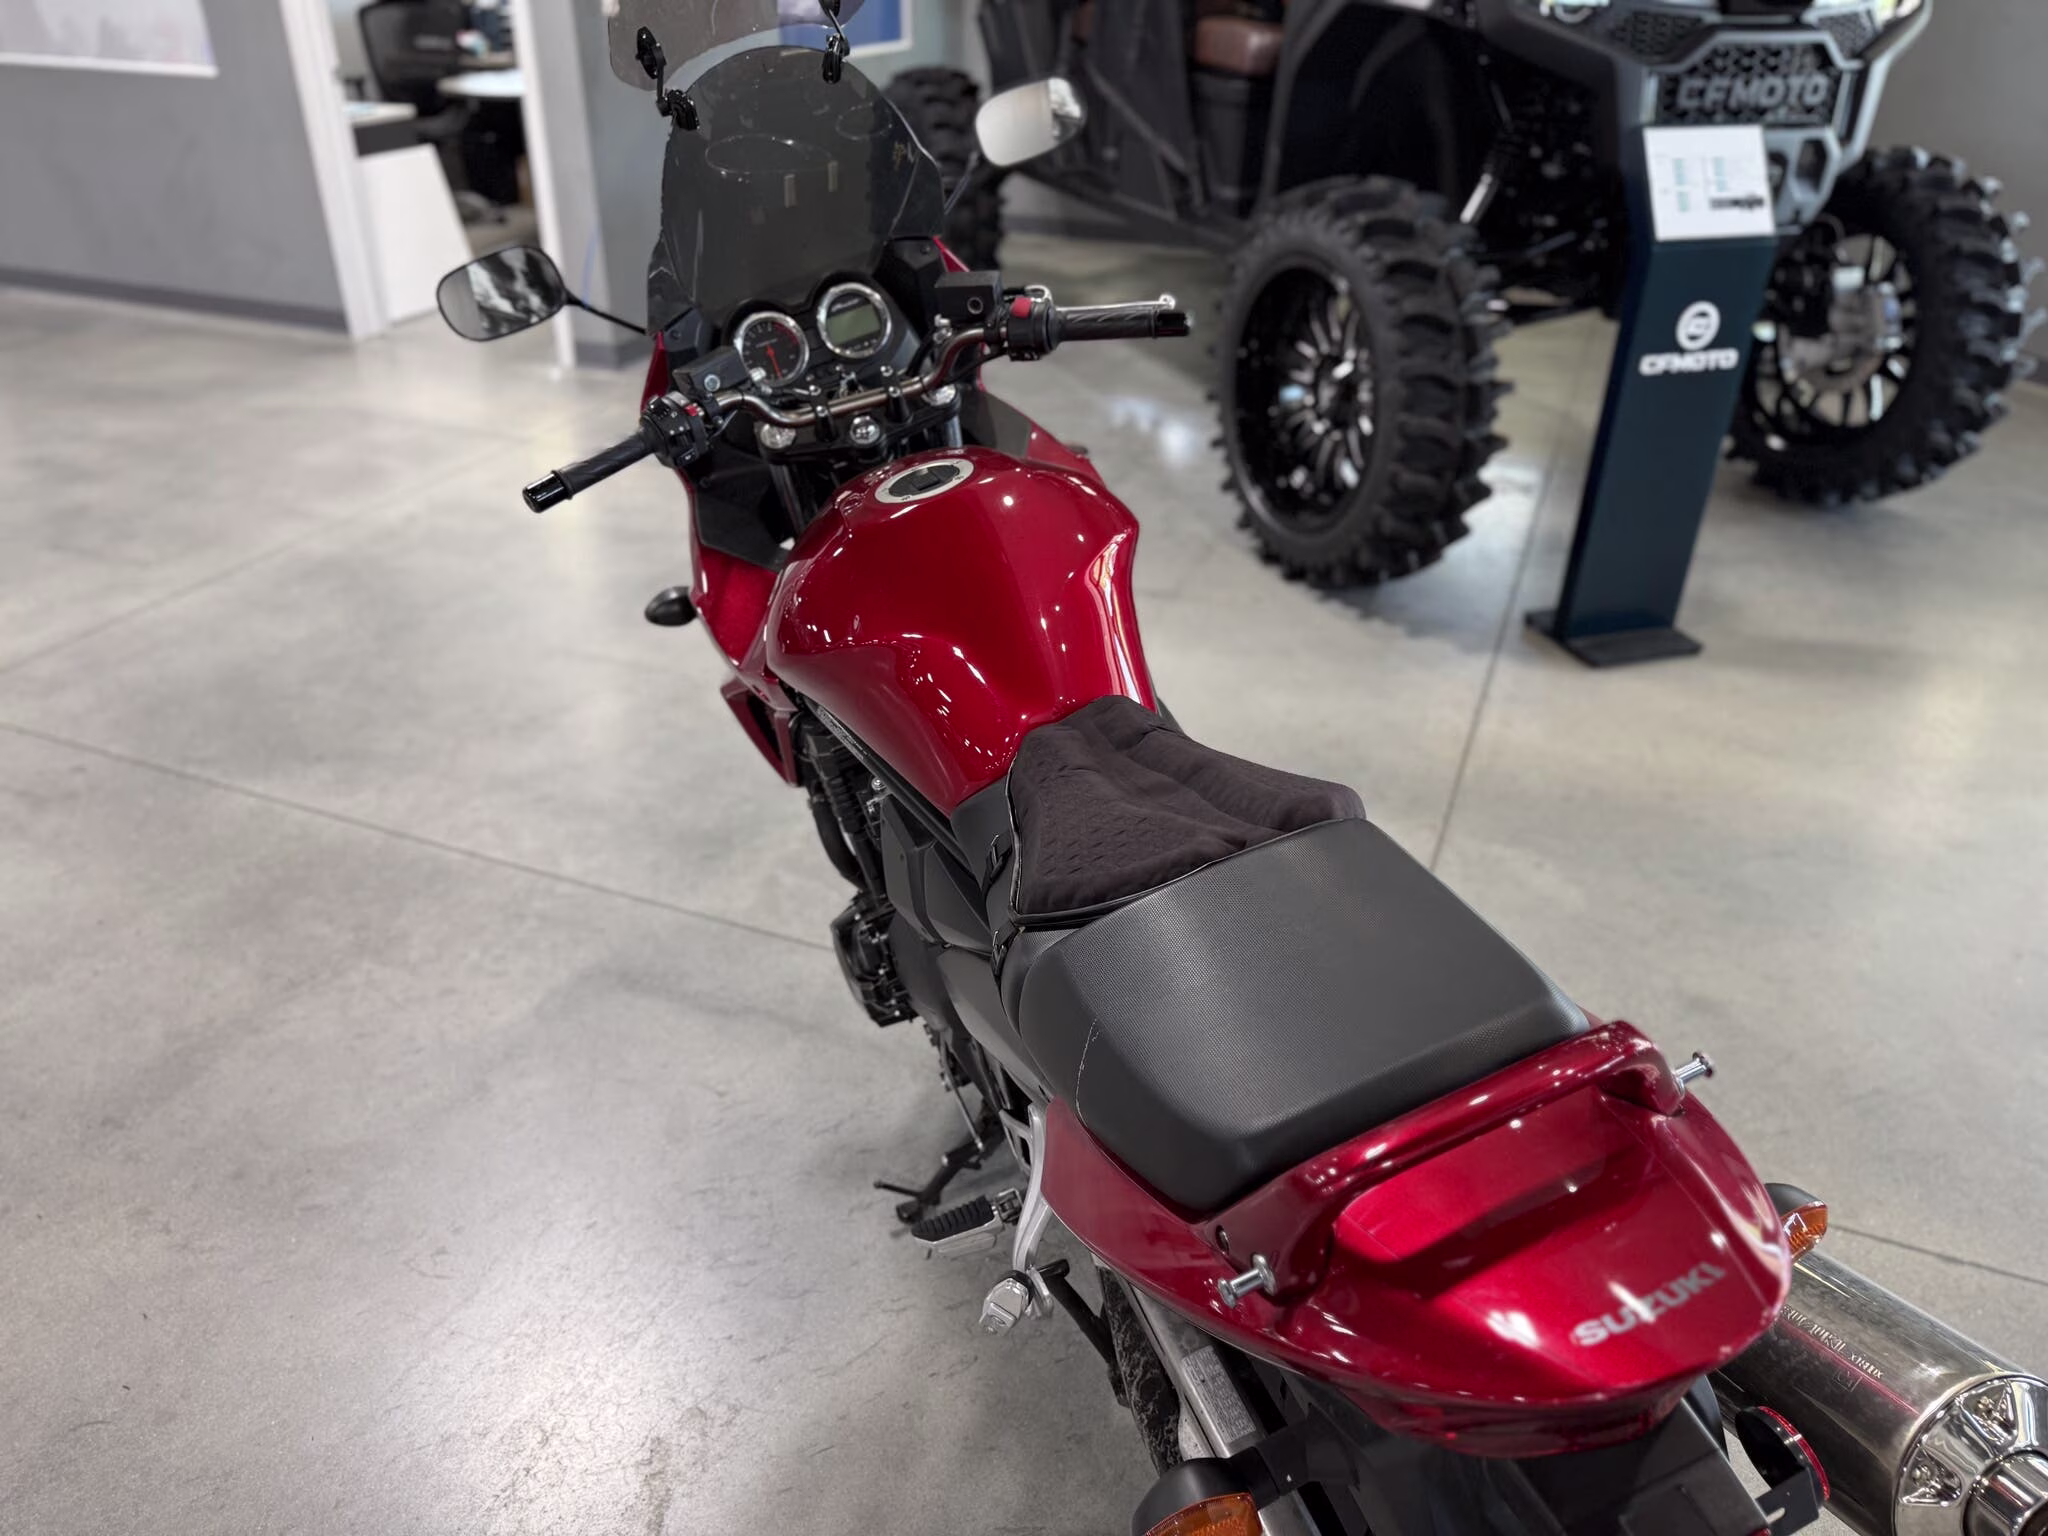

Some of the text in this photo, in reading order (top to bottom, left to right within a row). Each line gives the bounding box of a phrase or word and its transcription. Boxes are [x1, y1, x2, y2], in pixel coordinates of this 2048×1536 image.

[1676, 73, 1829, 110] CFMOTO
[1639, 348, 1739, 376] CFMOTO
[1571, 1261, 1726, 1346] SUZUKI
